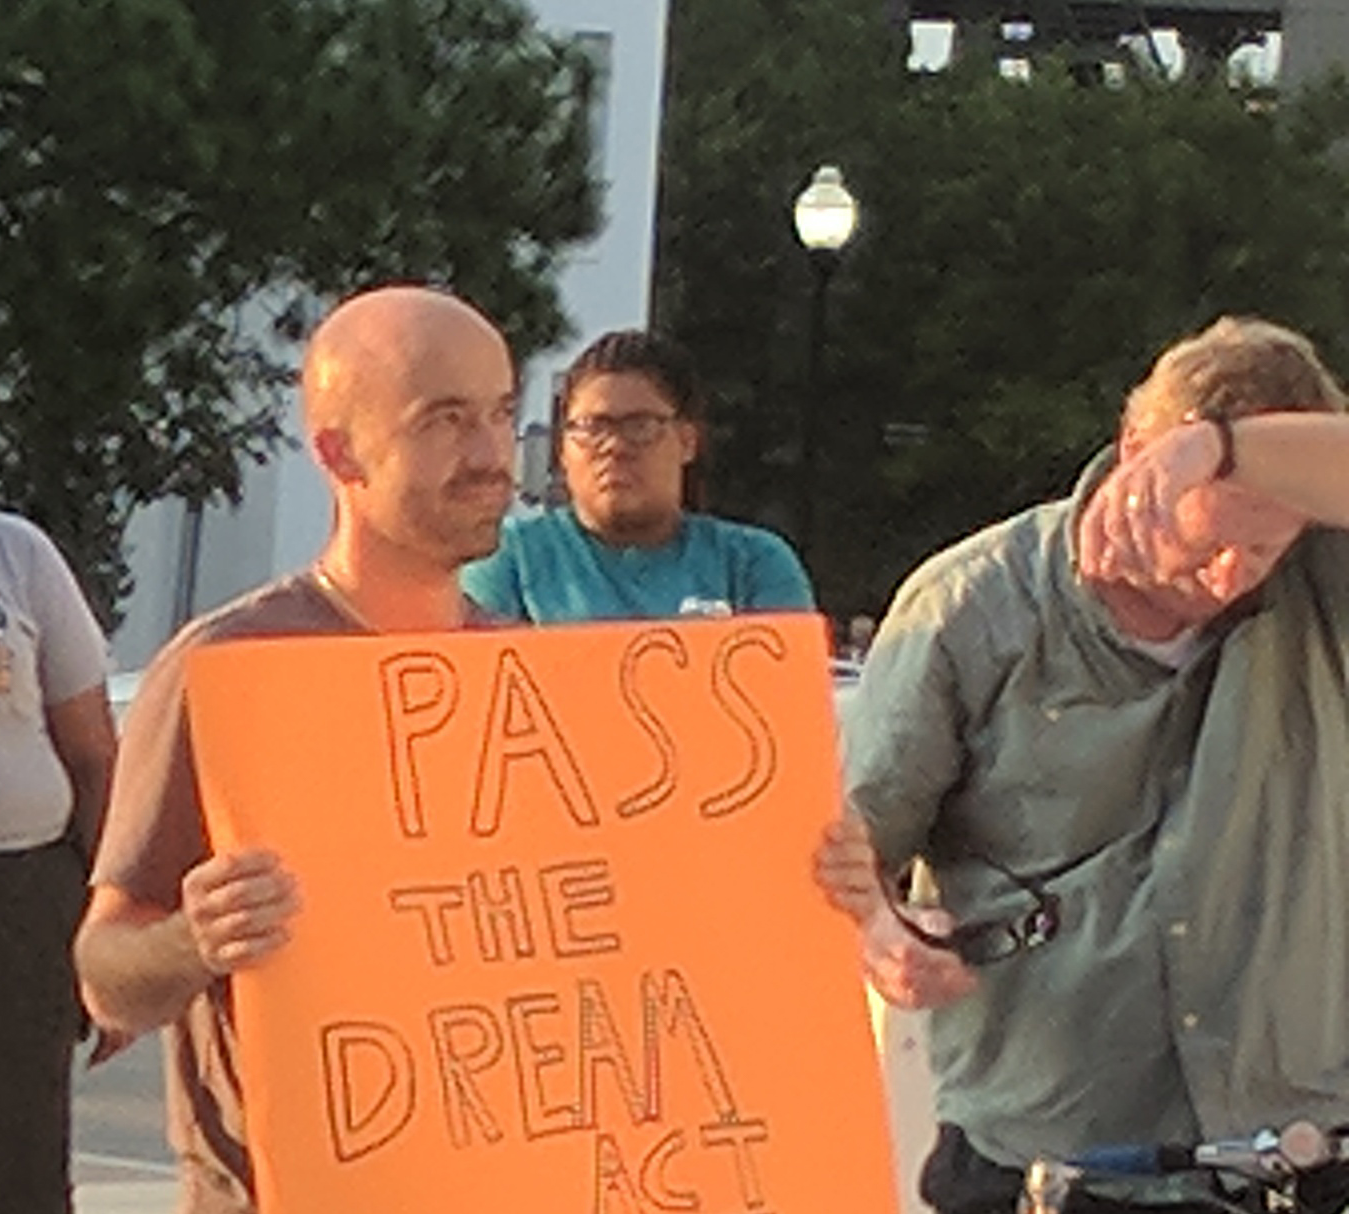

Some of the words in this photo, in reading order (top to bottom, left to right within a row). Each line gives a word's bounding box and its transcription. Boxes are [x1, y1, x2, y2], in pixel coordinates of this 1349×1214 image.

[379, 626, 788, 840] PASS
[388, 858, 622, 967] THE
[320, 967, 741, 1164] DREAM
